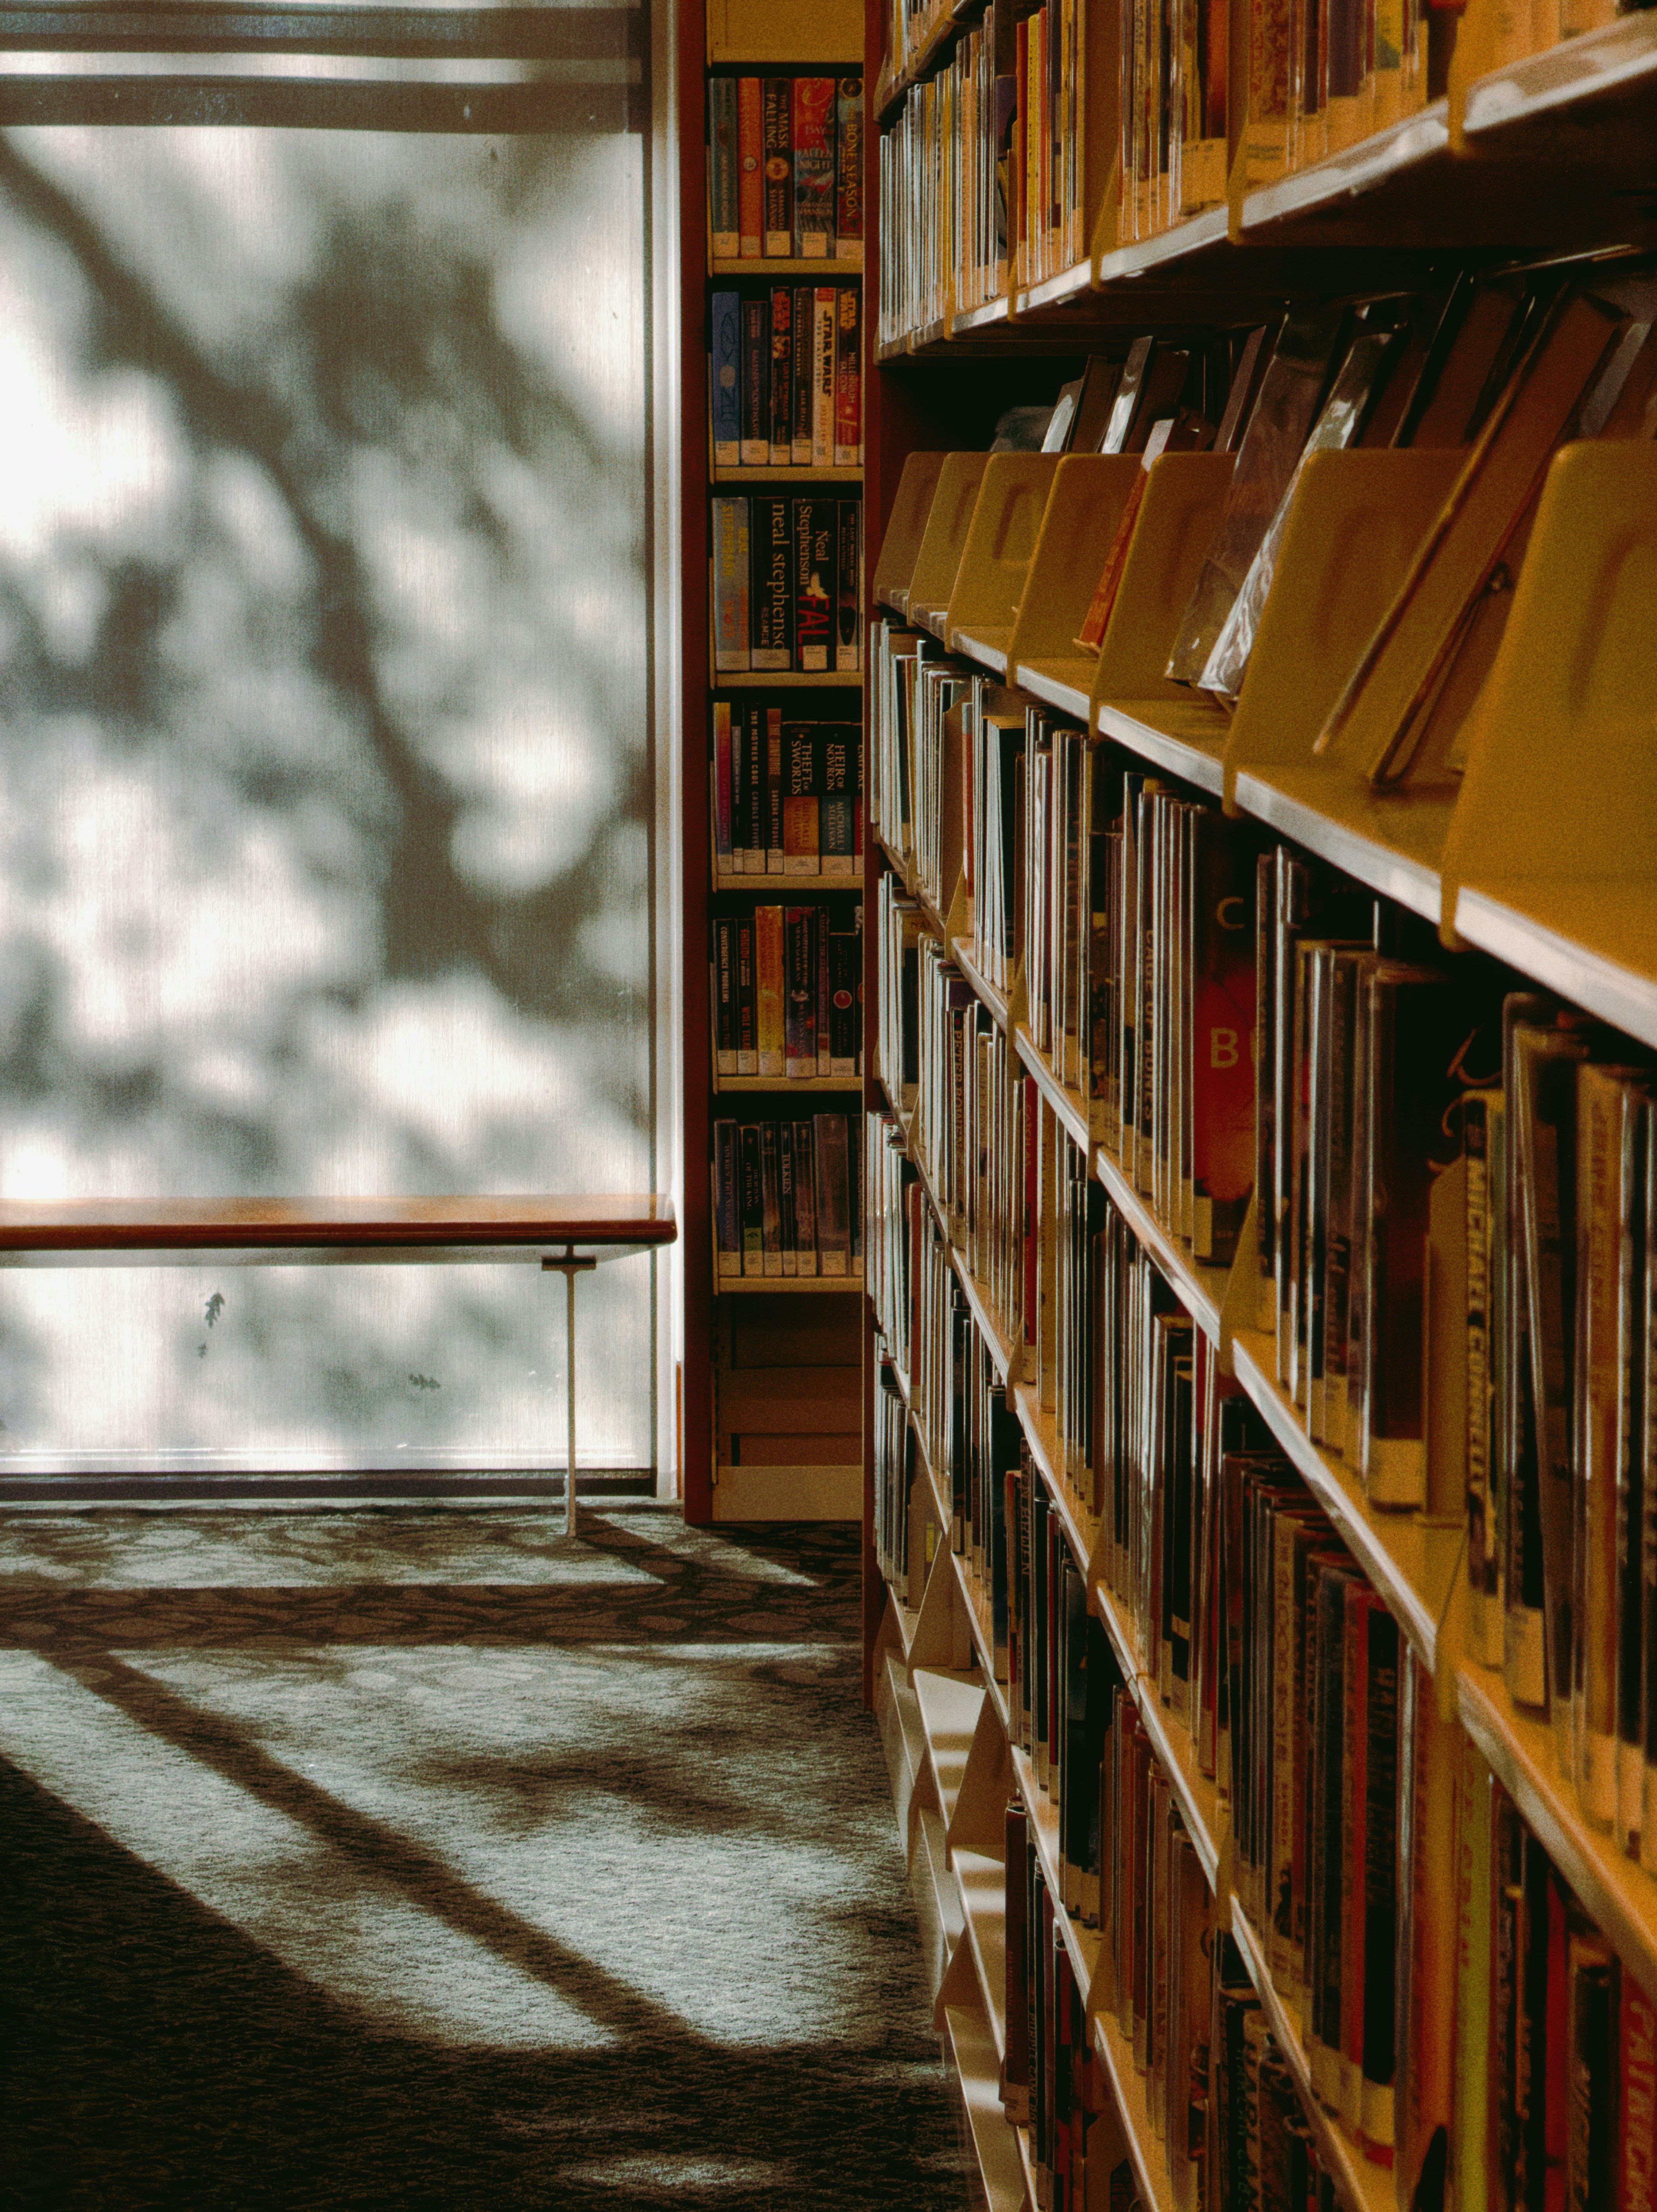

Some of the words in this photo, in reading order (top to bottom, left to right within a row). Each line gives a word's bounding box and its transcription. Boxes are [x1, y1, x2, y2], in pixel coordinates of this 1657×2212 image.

[766, 93, 777, 149] FALLING
[778, 113, 789, 149] MASK
[846, 124, 857, 162] BONE
[846, 165, 857, 217] SEASON
[839, 291, 848, 329] WARS
[848, 292, 856, 329] STAR
[823, 311, 832, 353] STAR
[823, 356, 831, 397] WARS
[847, 352, 856, 403] MILLENNIUM
[721, 506, 734, 575] STEPHENSON
[738, 528, 748, 553] NEAL
[772, 503, 790, 546] neal
[796, 505, 812, 585] Stephenson
[816, 531, 830, 561] Neal
[791, 741, 802, 795] SWORDS
[802, 743, 812, 782] THEFT
[826, 744, 834, 790] NOVRON
[834, 745, 845, 775] HEIR
[836, 777, 844, 788] OF
[828, 804, 836, 849] SULLIVAN
[740, 928, 749, 959] SHIGIDI
[955, 1029, 963, 1083] PETER
[1144, 1039, 1153, 1120] BONES
[955, 1087, 963, 1148] BOWEN
[782, 1153, 791, 1195] TOLKIEN
[1467, 1158, 1485, 1313] MICHAEL
[1236, 2148, 1247, 2208] COBE
